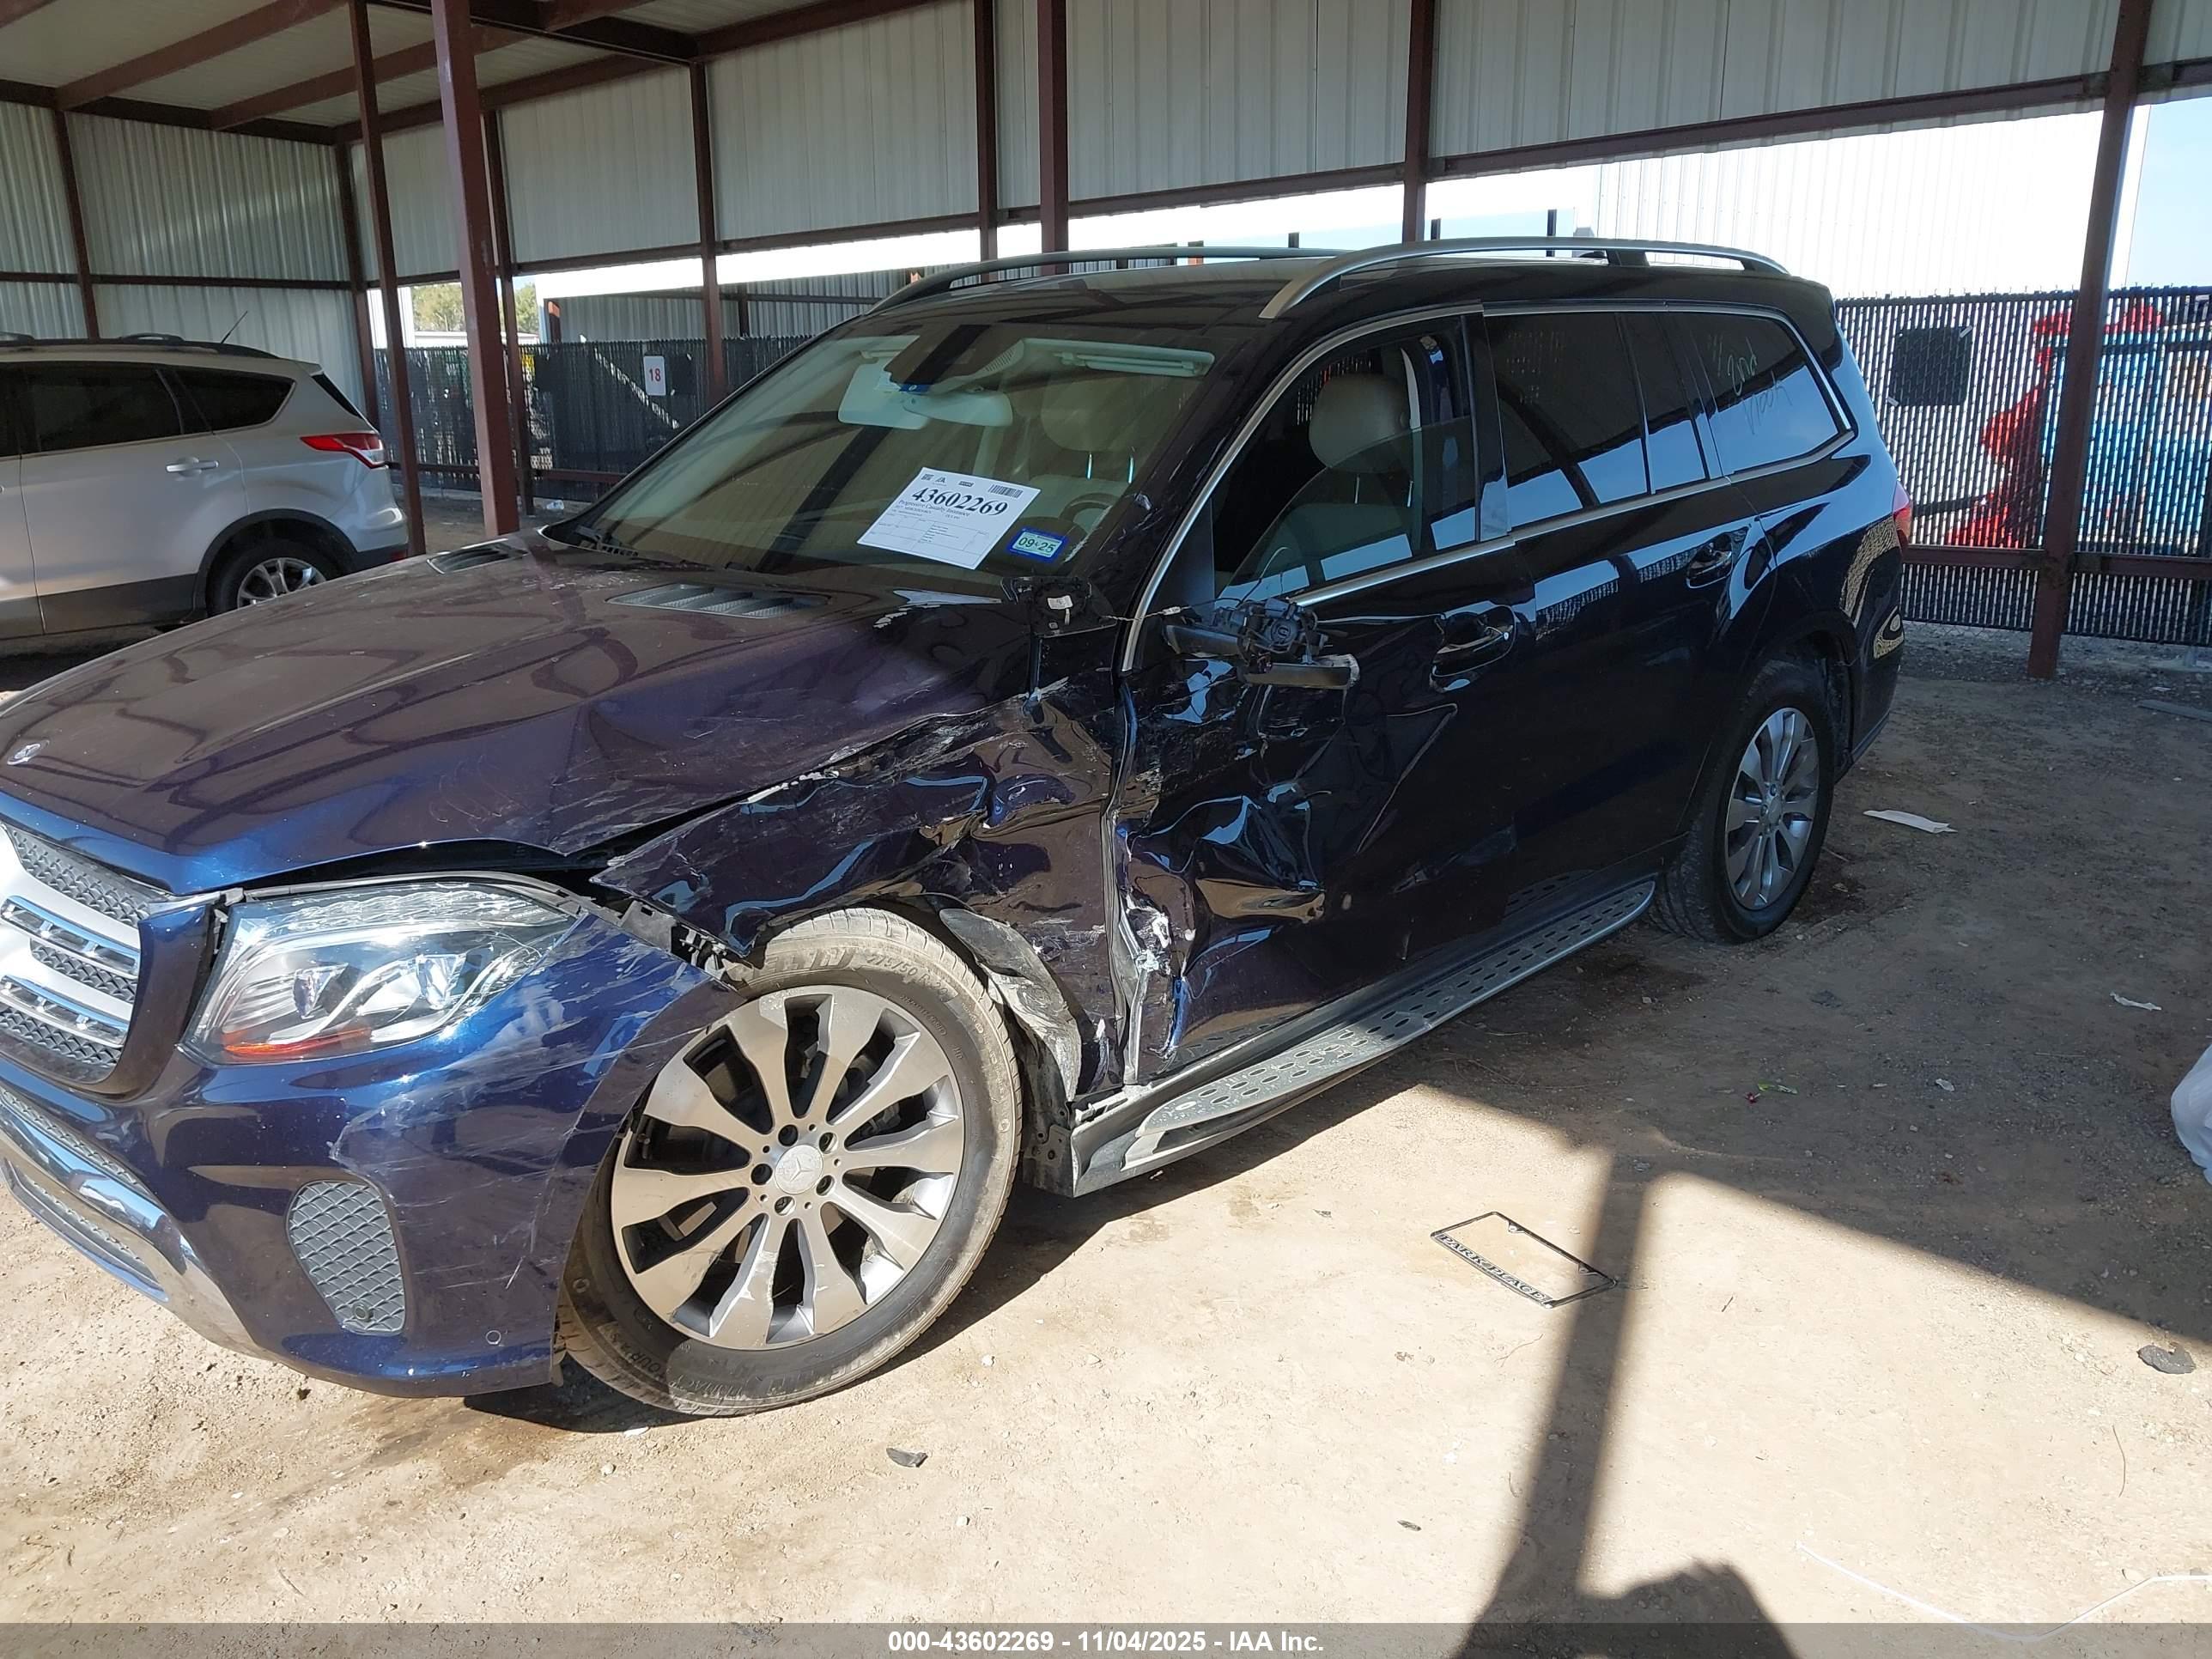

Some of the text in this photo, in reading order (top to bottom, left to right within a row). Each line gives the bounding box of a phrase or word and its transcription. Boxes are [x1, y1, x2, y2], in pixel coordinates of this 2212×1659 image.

[649, 368, 661, 382] 18
[911, 487, 1009, 516] 43602269
[1018, 537, 1036, 548] 09
[1037, 542, 1056, 553] 25
[1440, 1235, 1546, 1300] PARK PLACE
